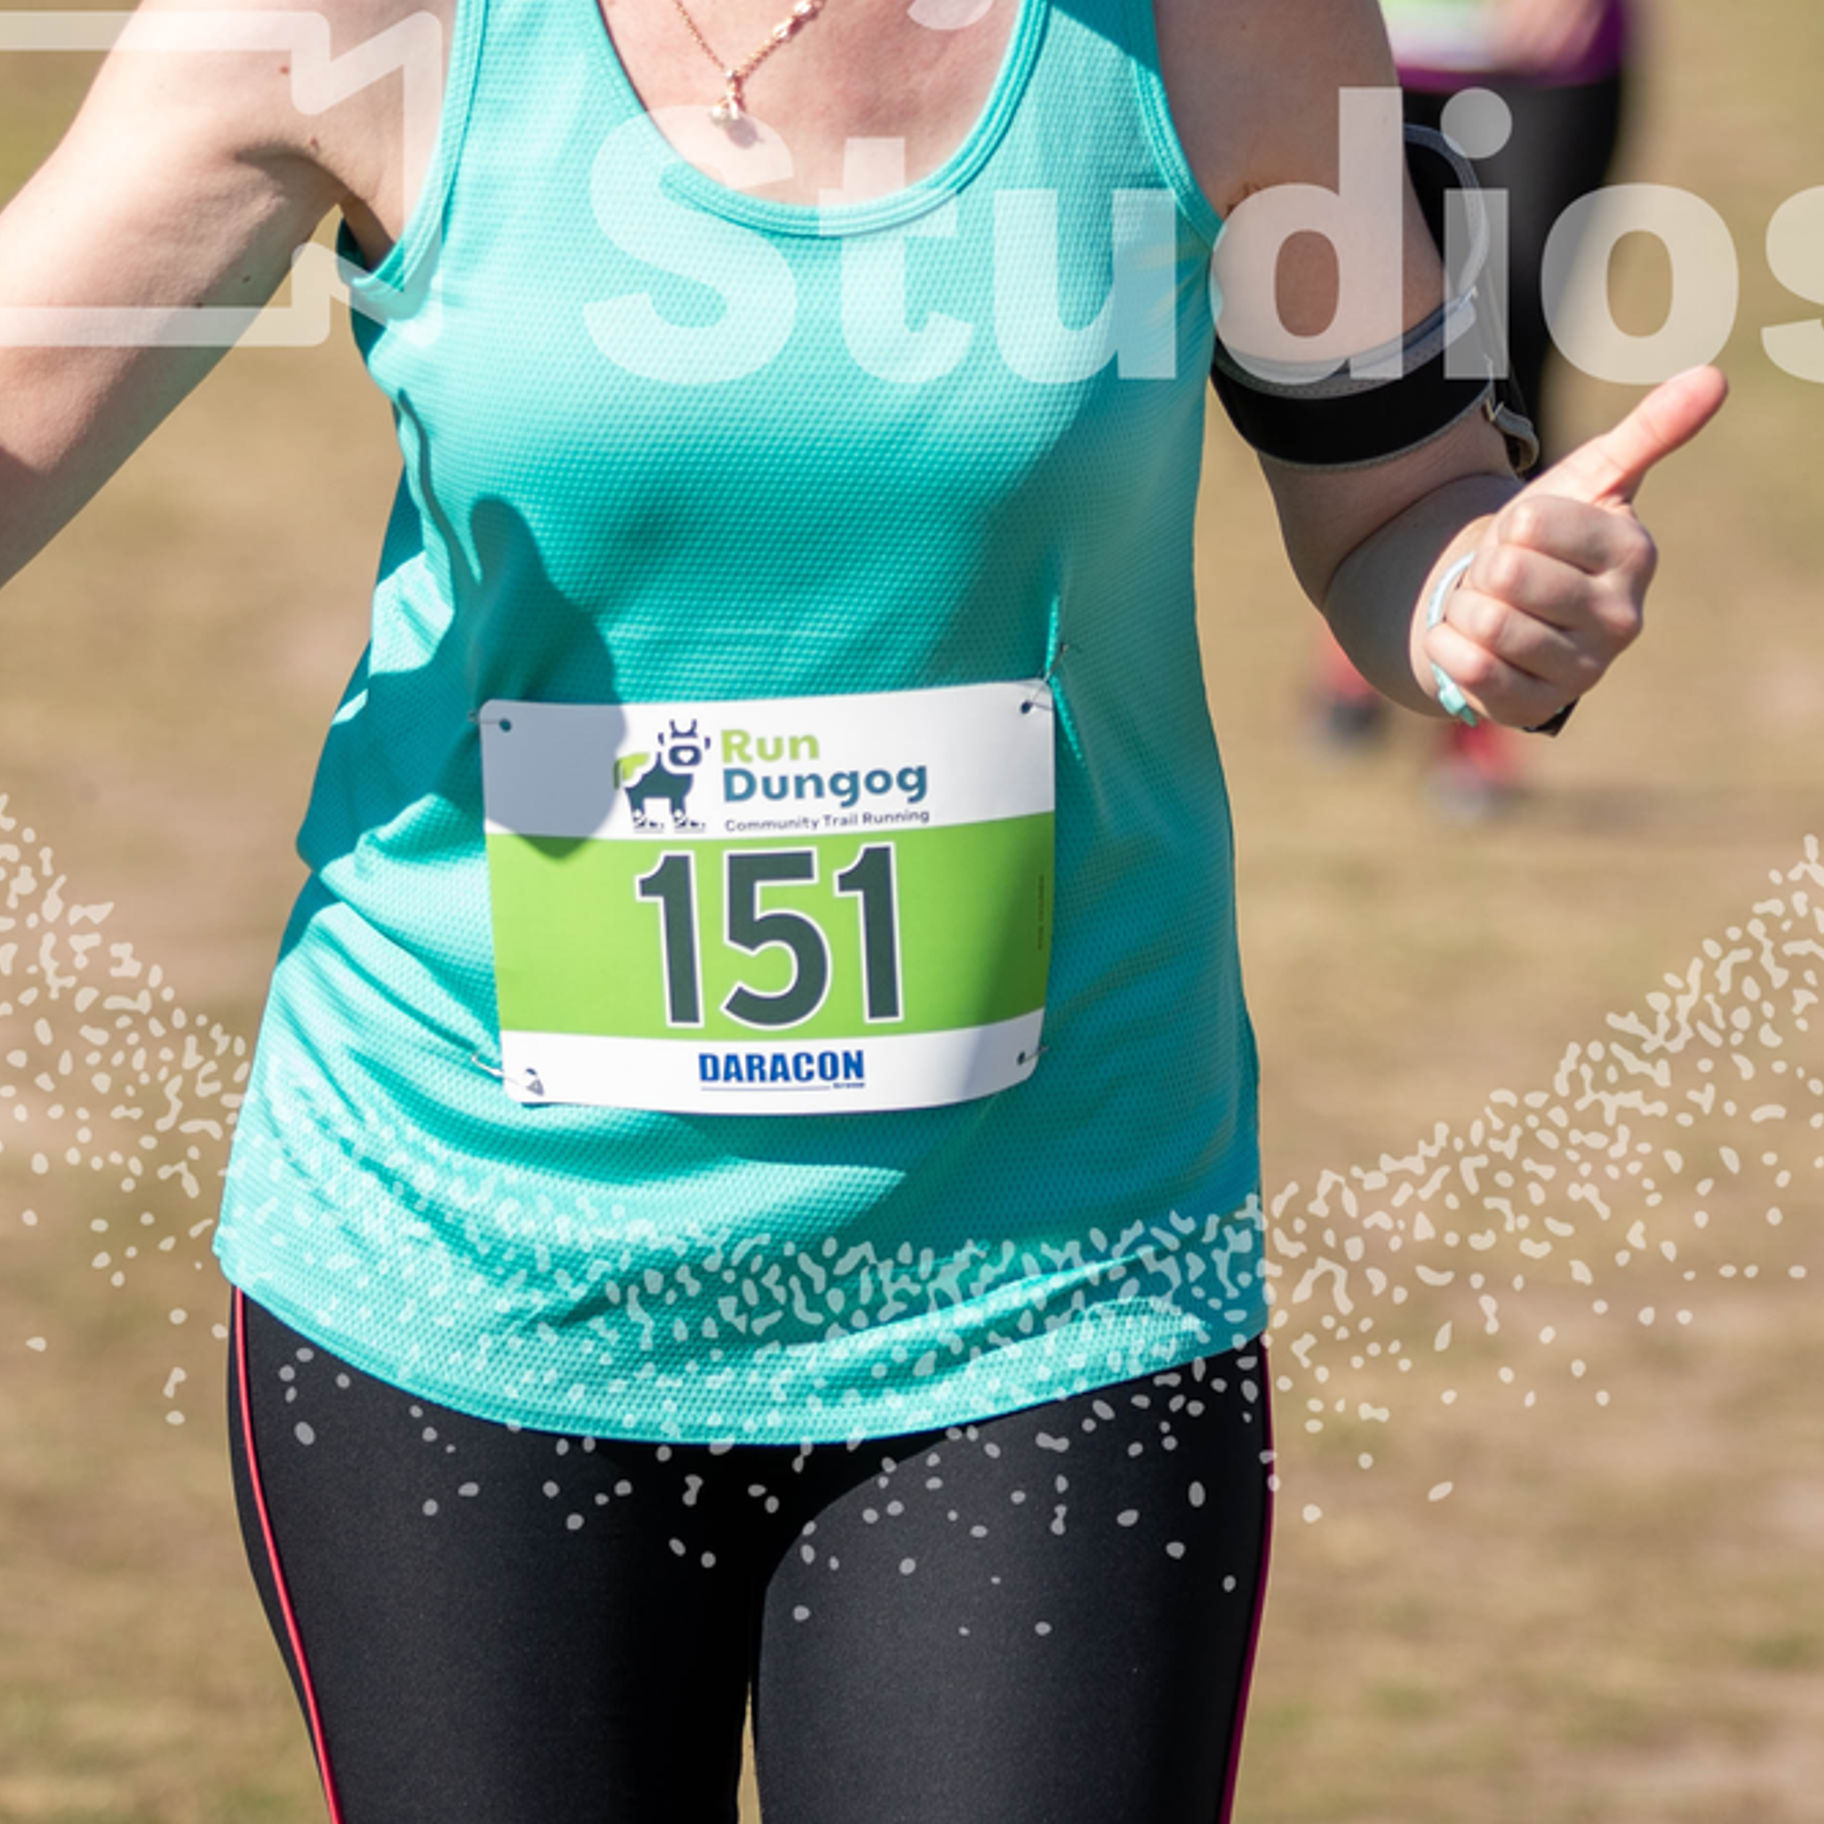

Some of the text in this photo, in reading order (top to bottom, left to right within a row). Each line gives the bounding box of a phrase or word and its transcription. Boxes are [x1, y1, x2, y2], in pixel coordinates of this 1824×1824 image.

[721, 729, 821, 764] Run
[723, 765, 927, 808] Dungog
[725, 809, 930, 833] Community Trail Running
[636, 844, 902, 1027] 151
[698, 1050, 865, 1083] DARACON
